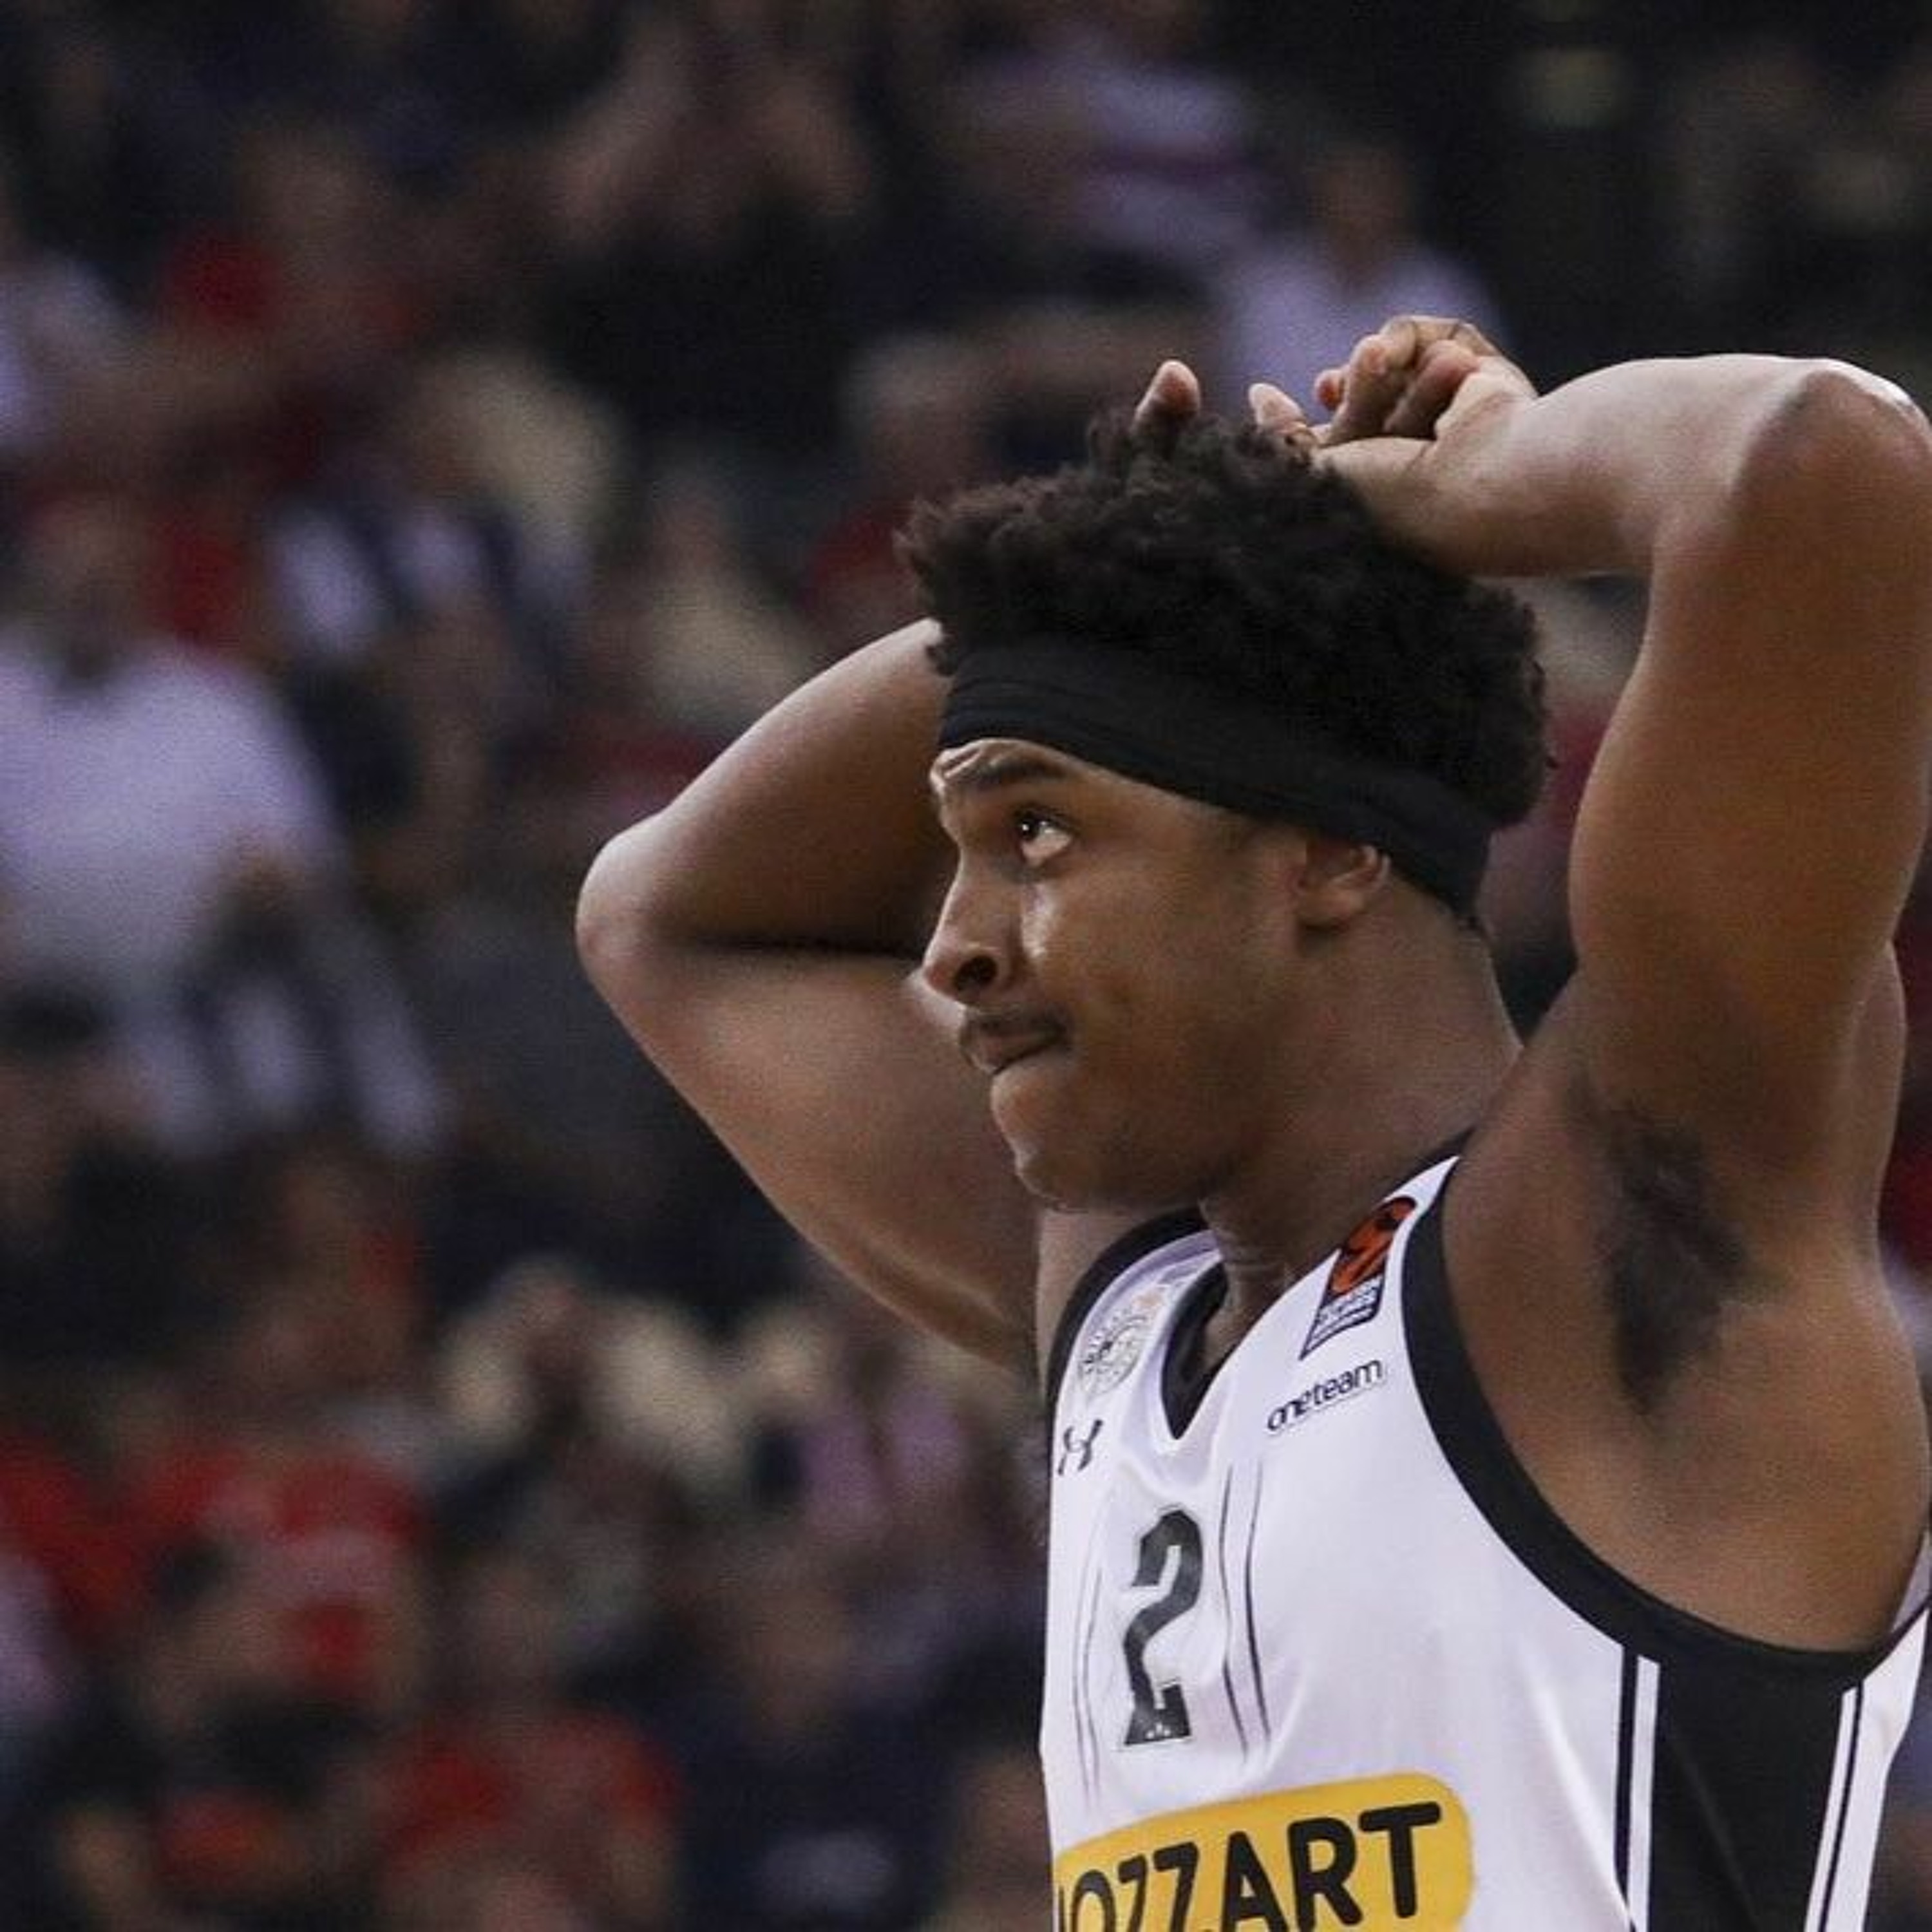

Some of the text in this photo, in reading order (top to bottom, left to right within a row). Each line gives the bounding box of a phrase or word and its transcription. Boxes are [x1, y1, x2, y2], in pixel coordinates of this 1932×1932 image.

[1267, 1359, 1384, 1432] oneteam
[1122, 1508, 1203, 1746] 2
[1059, 1801, 1442, 1932] OZZART
